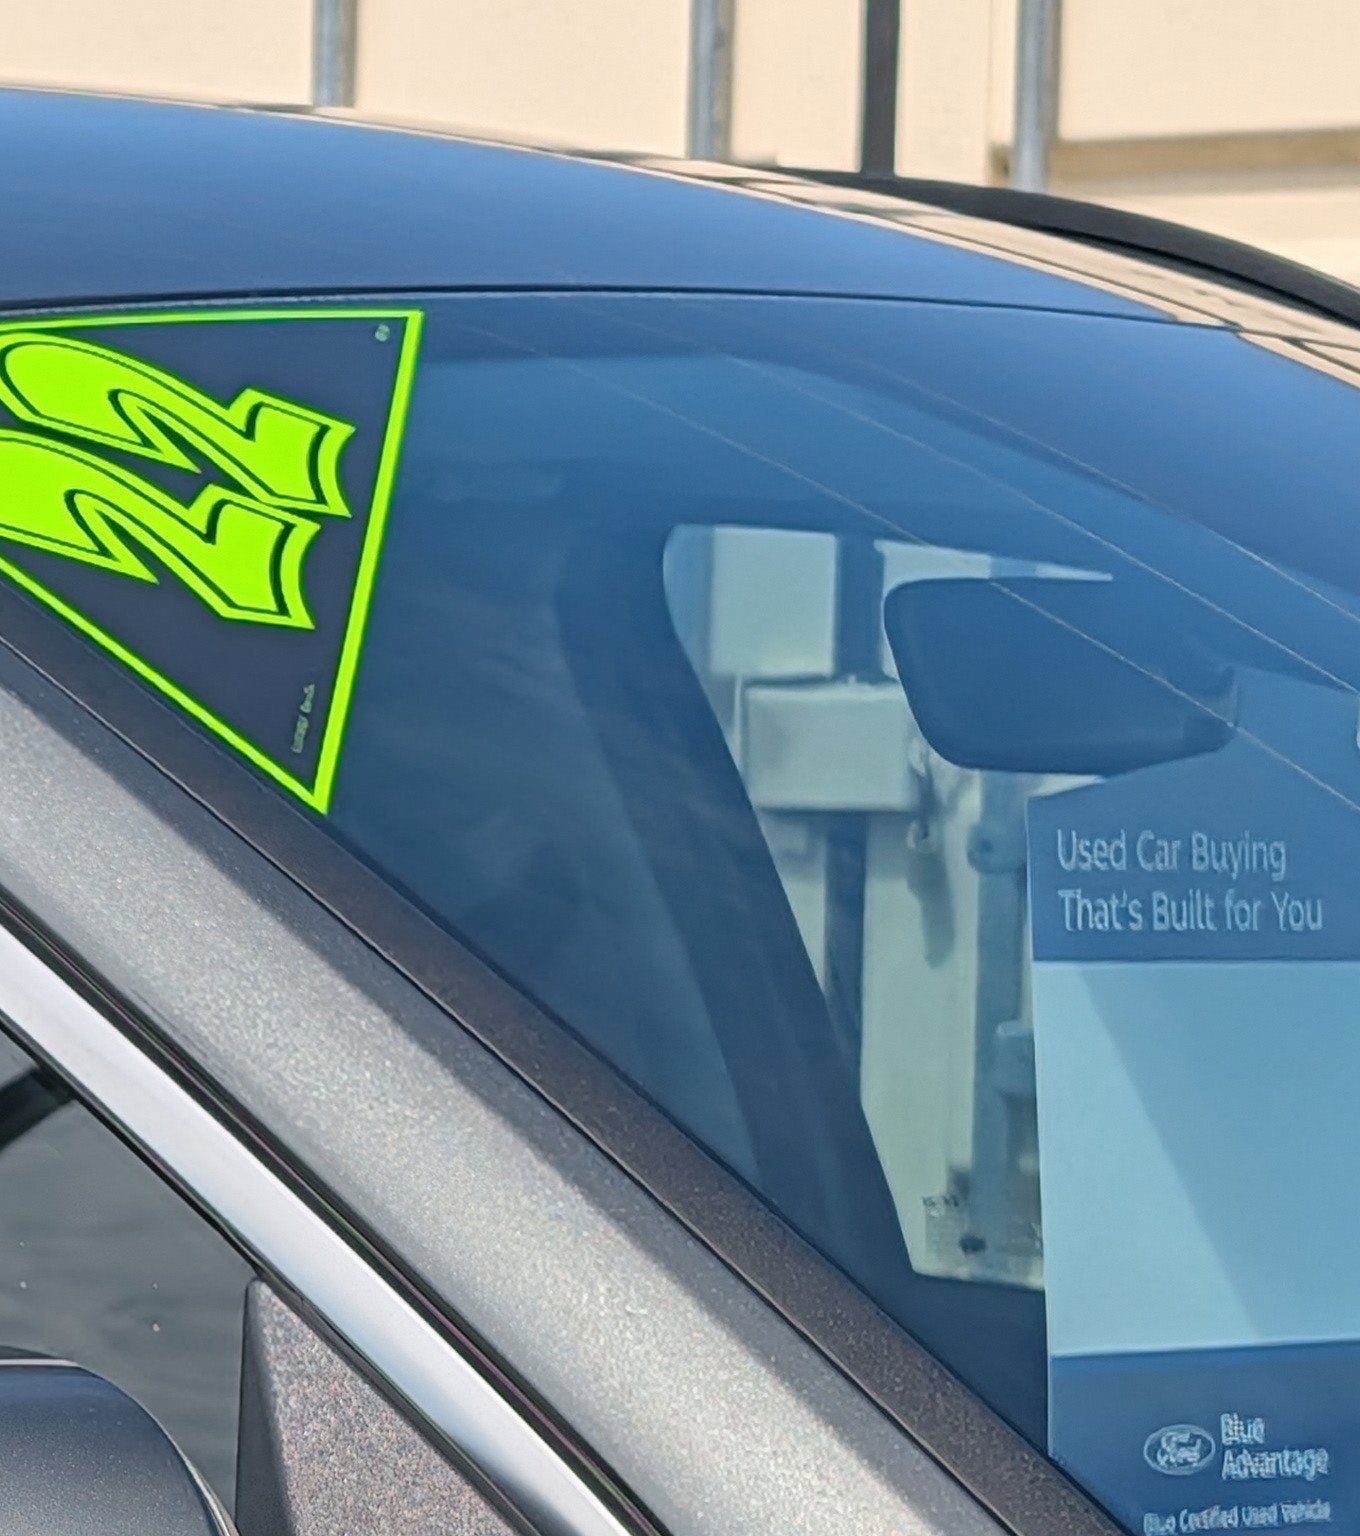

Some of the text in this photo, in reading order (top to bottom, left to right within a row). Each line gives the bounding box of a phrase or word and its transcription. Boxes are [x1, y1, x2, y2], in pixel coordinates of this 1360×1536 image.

[1056, 828, 1286, 882] Used Car Buying
[1057, 888, 1324, 932] That's Built for You
[1220, 1411, 1265, 1445] Blue
[1221, 1446, 1329, 1481] Advantage
